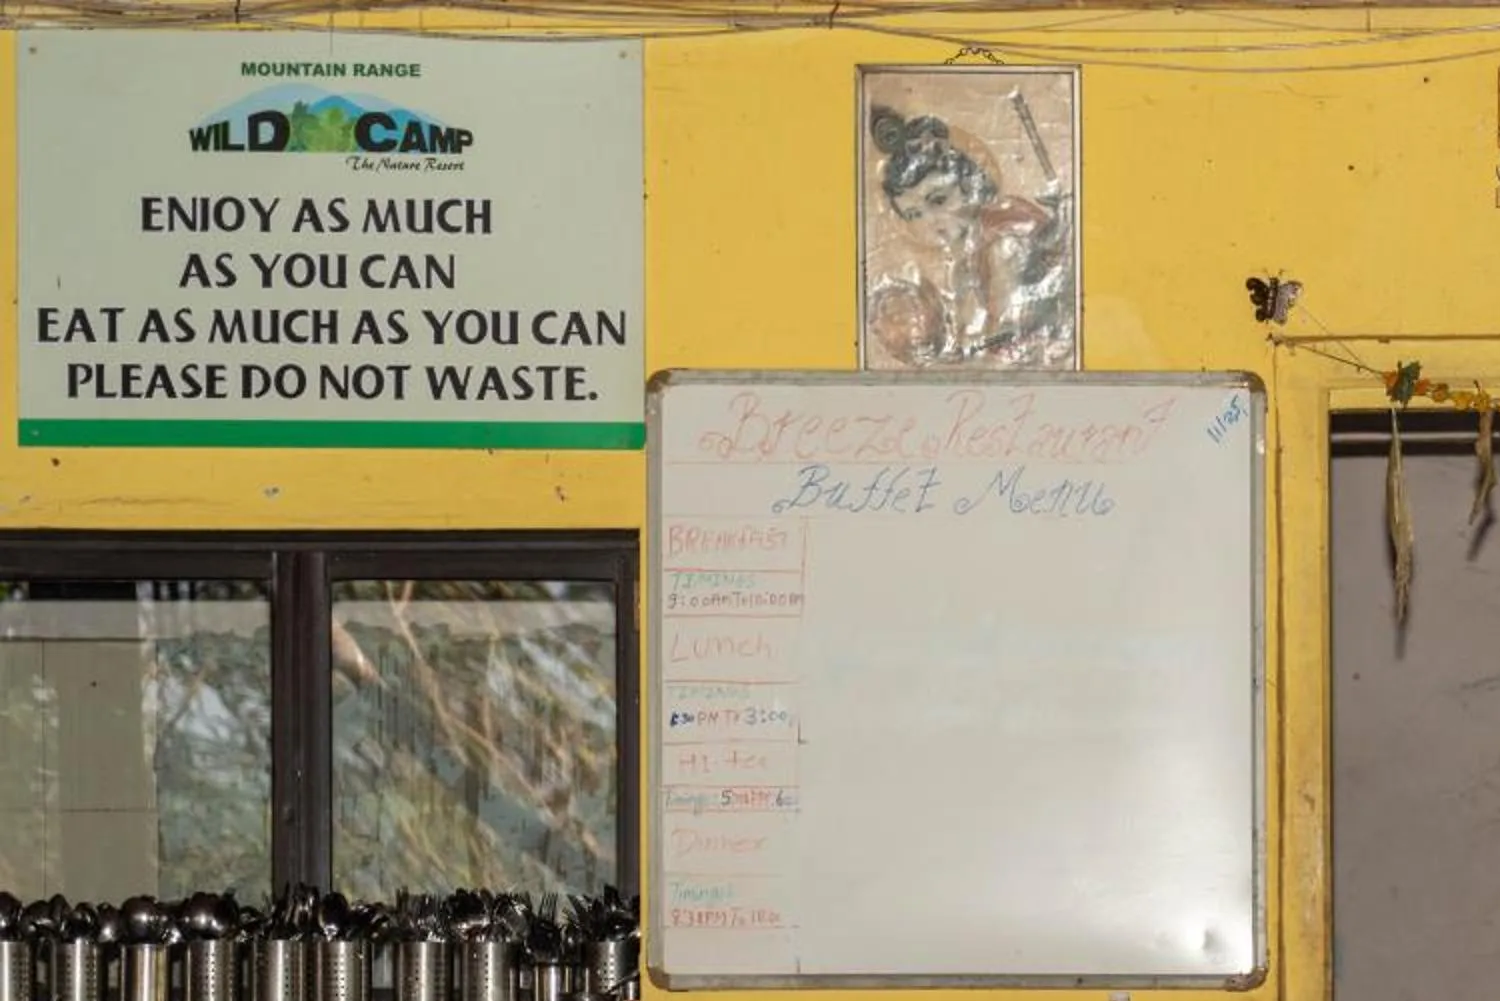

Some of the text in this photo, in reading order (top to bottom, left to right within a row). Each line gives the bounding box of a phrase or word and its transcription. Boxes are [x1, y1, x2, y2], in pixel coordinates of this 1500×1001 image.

[241, 62, 421, 78] MOUNTAIN RANGE
[189, 110, 474, 154] WILD CAMP
[346, 156, 465, 172] The Nature Resort
[291, 197, 350, 234] AS
[362, 198, 492, 235] MUCH
[178, 252, 455, 289] AS YOU CAN
[37, 307, 626, 346] EAT AS MUCH AS YOU CAN
[67, 363, 598, 401] PLEASE DO NOT WASTE.
[771, 462, 1116, 515] Buffet Menu
